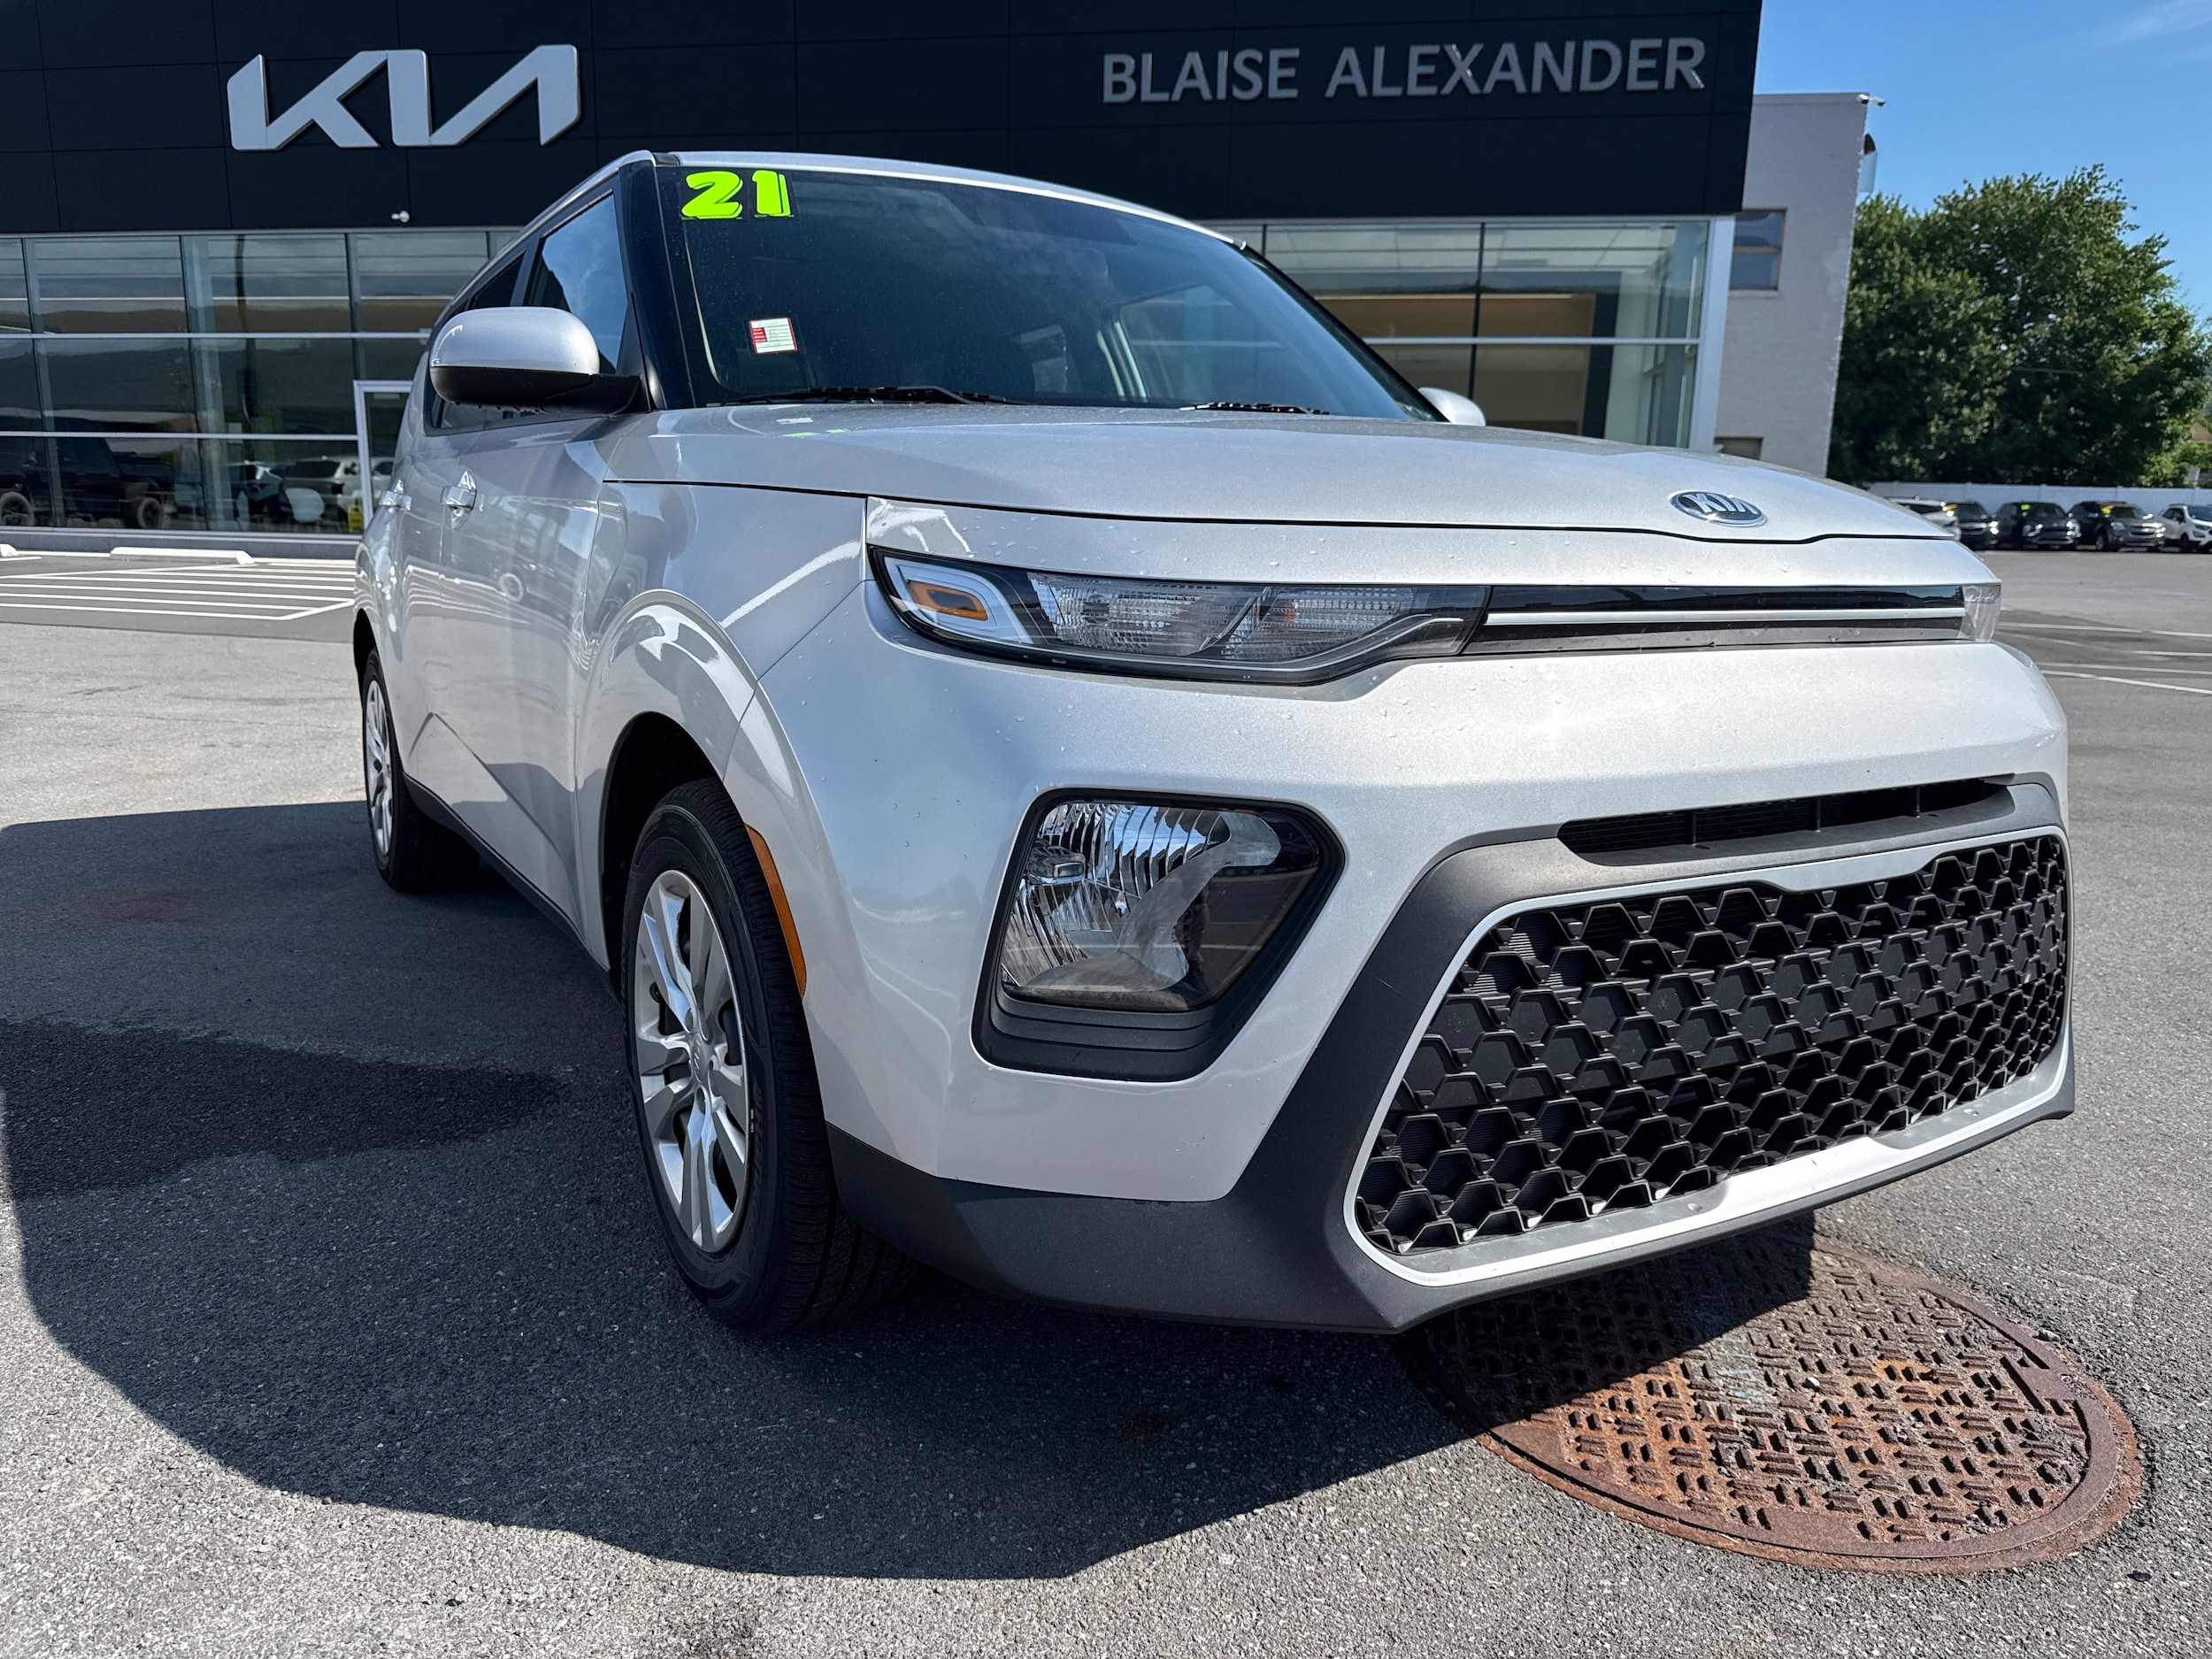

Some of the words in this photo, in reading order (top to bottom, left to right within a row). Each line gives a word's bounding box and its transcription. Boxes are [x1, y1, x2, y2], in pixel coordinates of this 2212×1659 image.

[227, 44, 581, 151] KIA
[1102, 48, 1301, 104] BLAISE
[1325, 37, 1707, 99] ALEXANDER
[681, 170, 791, 219] 21
[1683, 493, 1758, 513] KIA
